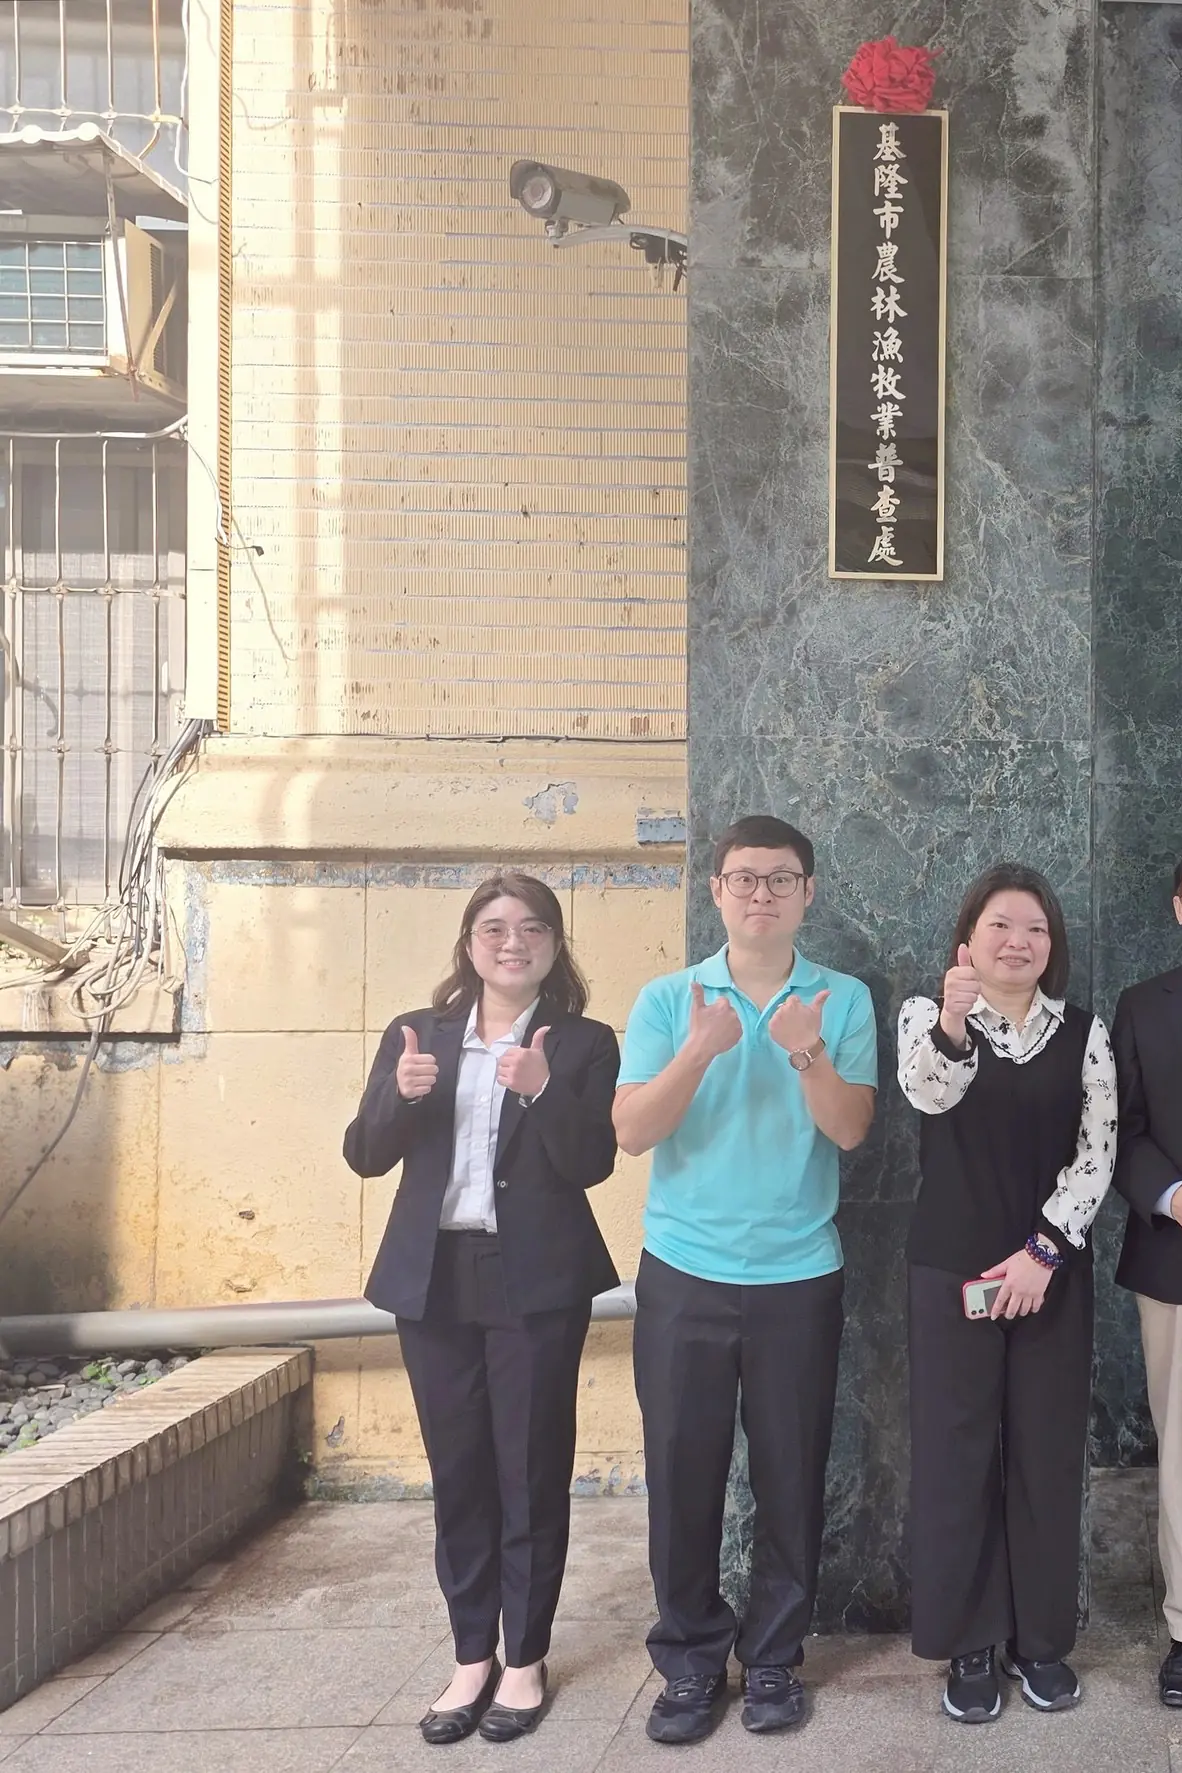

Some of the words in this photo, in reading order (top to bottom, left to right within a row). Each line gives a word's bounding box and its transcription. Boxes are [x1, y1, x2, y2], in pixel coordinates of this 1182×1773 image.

[867, 121, 909, 567] 基隆市農林漁牧業普查處
